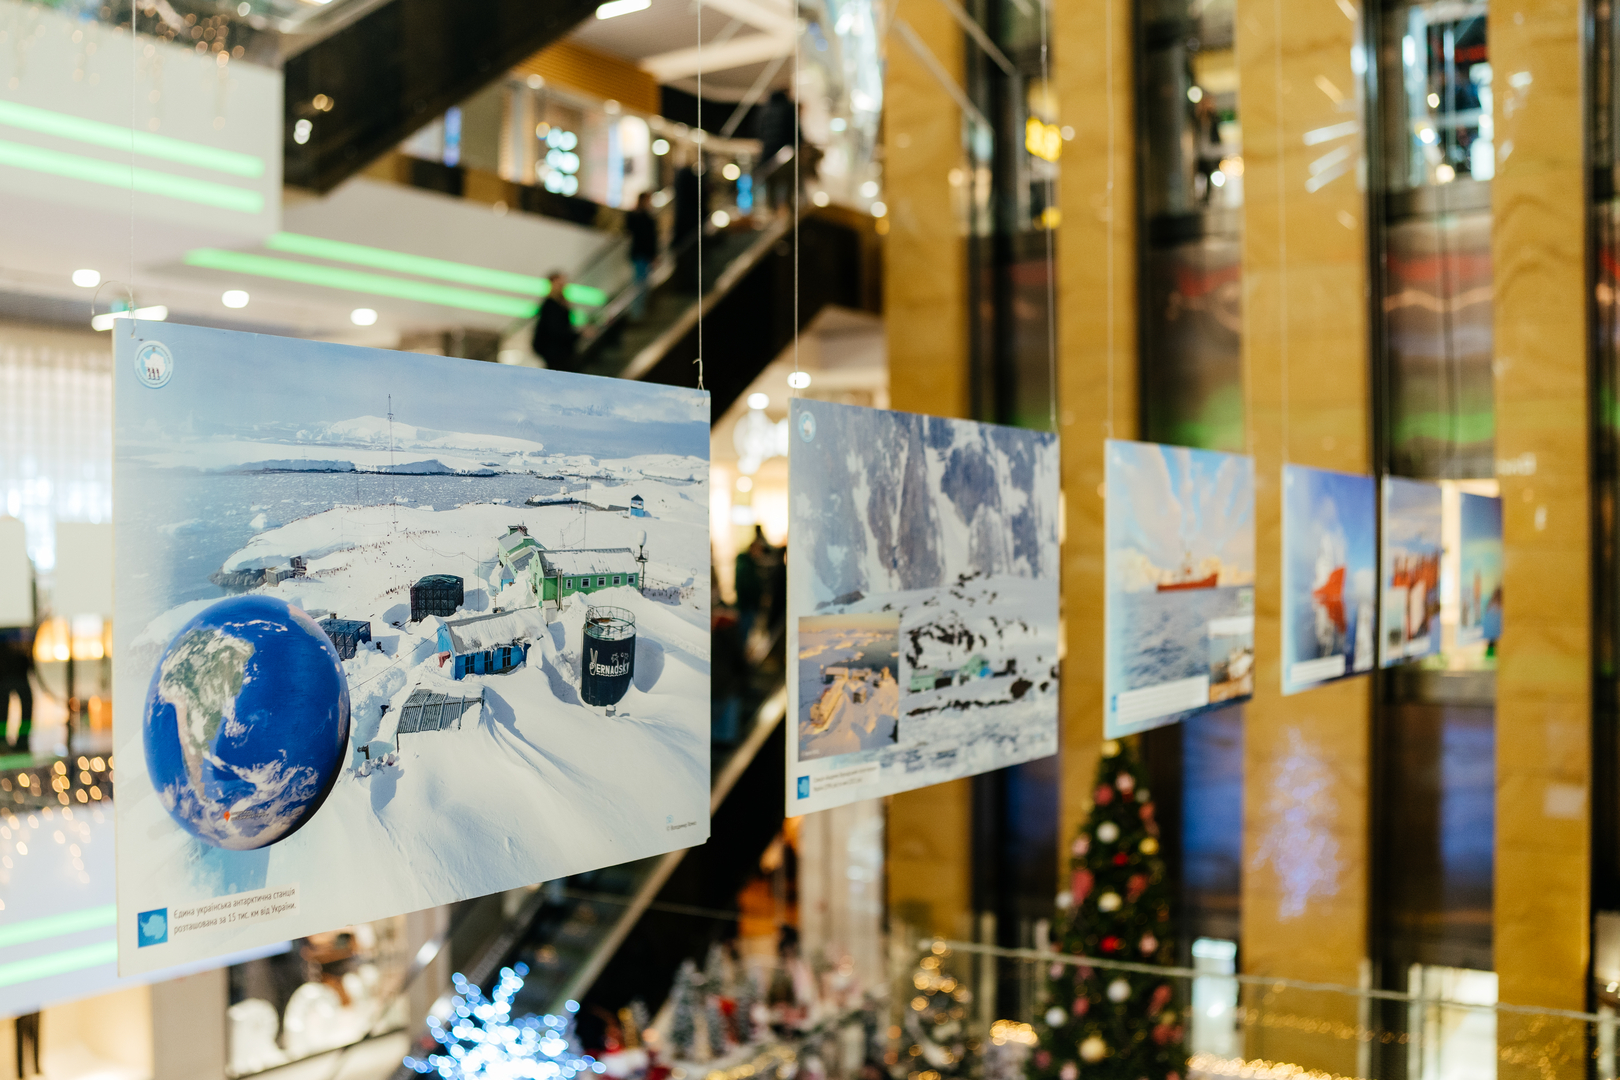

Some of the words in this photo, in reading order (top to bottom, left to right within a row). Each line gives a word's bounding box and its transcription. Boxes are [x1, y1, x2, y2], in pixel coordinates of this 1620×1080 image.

[173, 908, 195, 919] Єдина
[196, 901, 232, 917] українська
[233, 894, 272, 907] антарктична
[272, 887, 295, 900] станція
[173, 918, 218, 936] розташована
[219, 916, 227, 925] за
[228, 912, 236, 922] 15
[237, 911, 249, 921] тис.
[250, 909, 259, 918] км
[260, 906, 270, 916] від
[271, 902, 297, 915] України.
